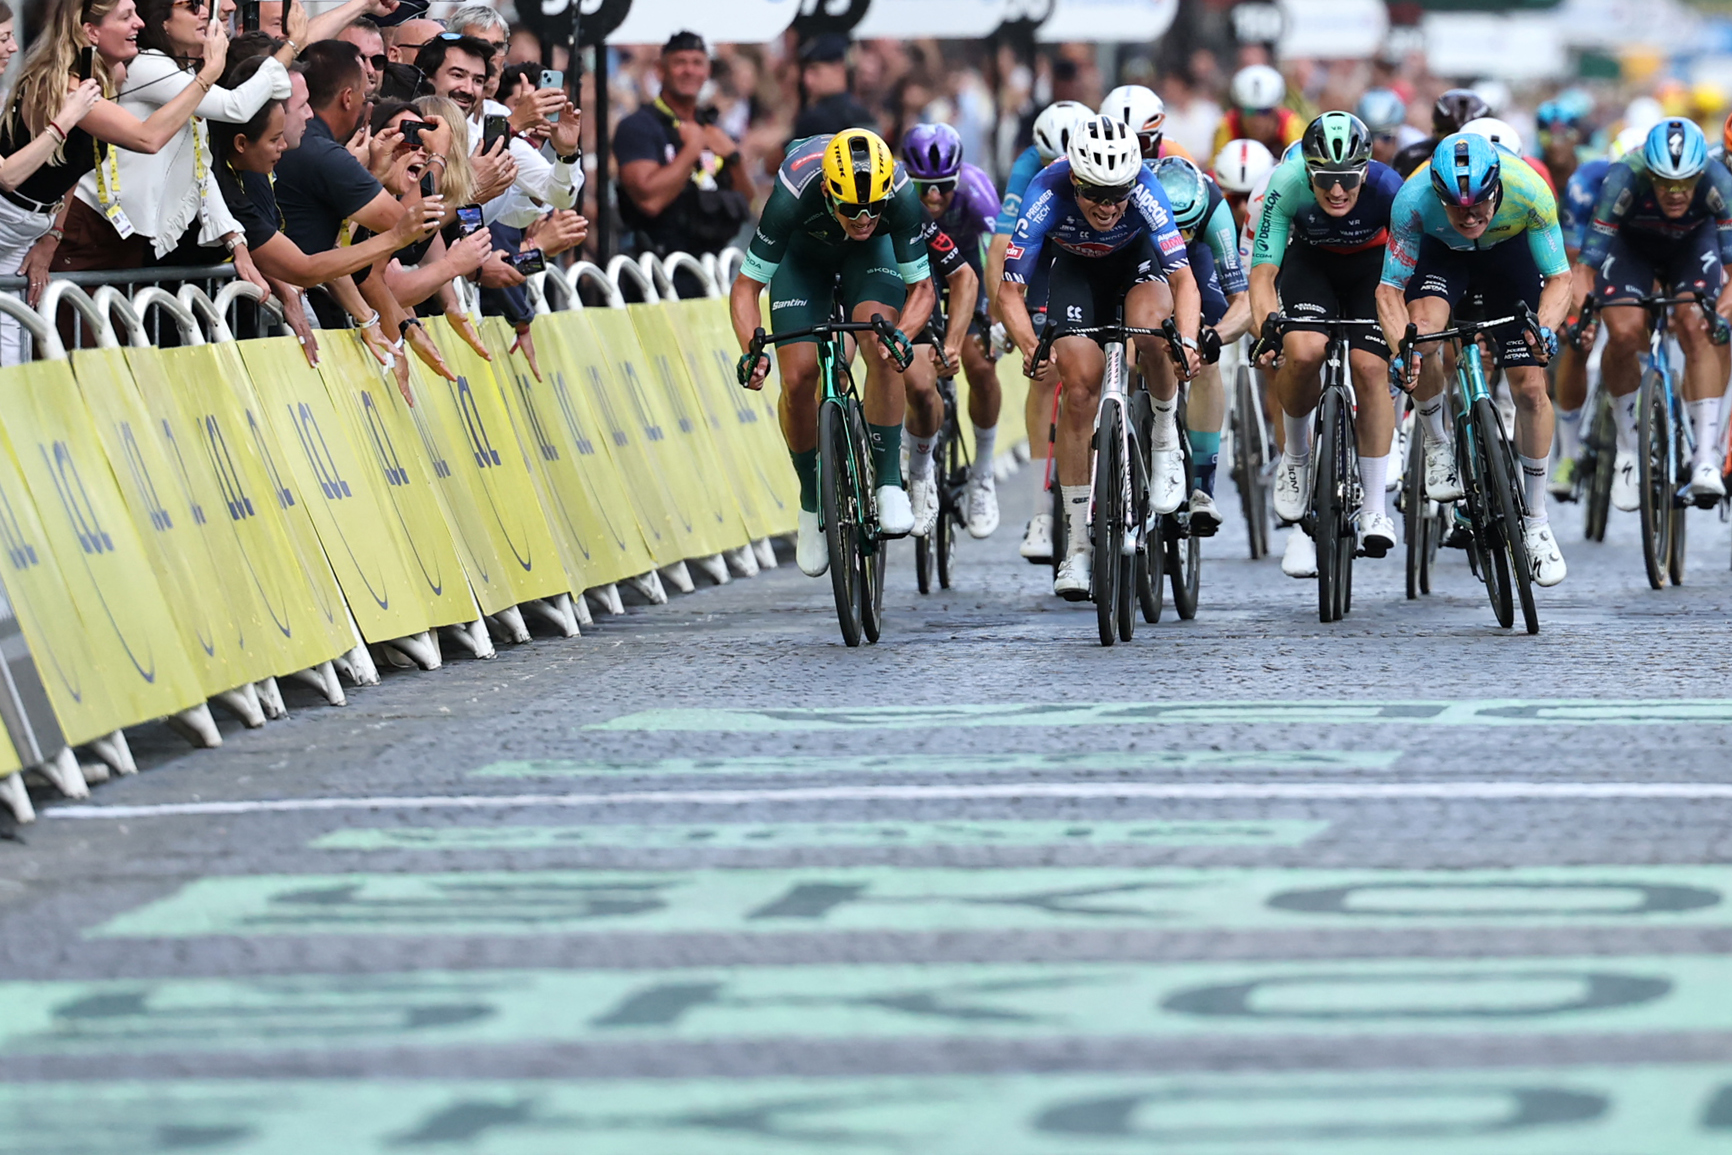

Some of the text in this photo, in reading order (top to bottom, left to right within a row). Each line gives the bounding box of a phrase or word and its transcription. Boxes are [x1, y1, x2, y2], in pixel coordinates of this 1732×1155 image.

[834, 144, 847, 178] TREK
[1025, 188, 1054, 220] PREMIER
[1032, 204, 1051, 225] TECH
[1132, 183, 1169, 228] Alpecin
[1262, 189, 1281, 239] DECATHLON
[1221, 228, 1239, 270] Bianchi
[772, 298, 808, 311] Santini
[1420, 286, 1449, 295] ASTANA
